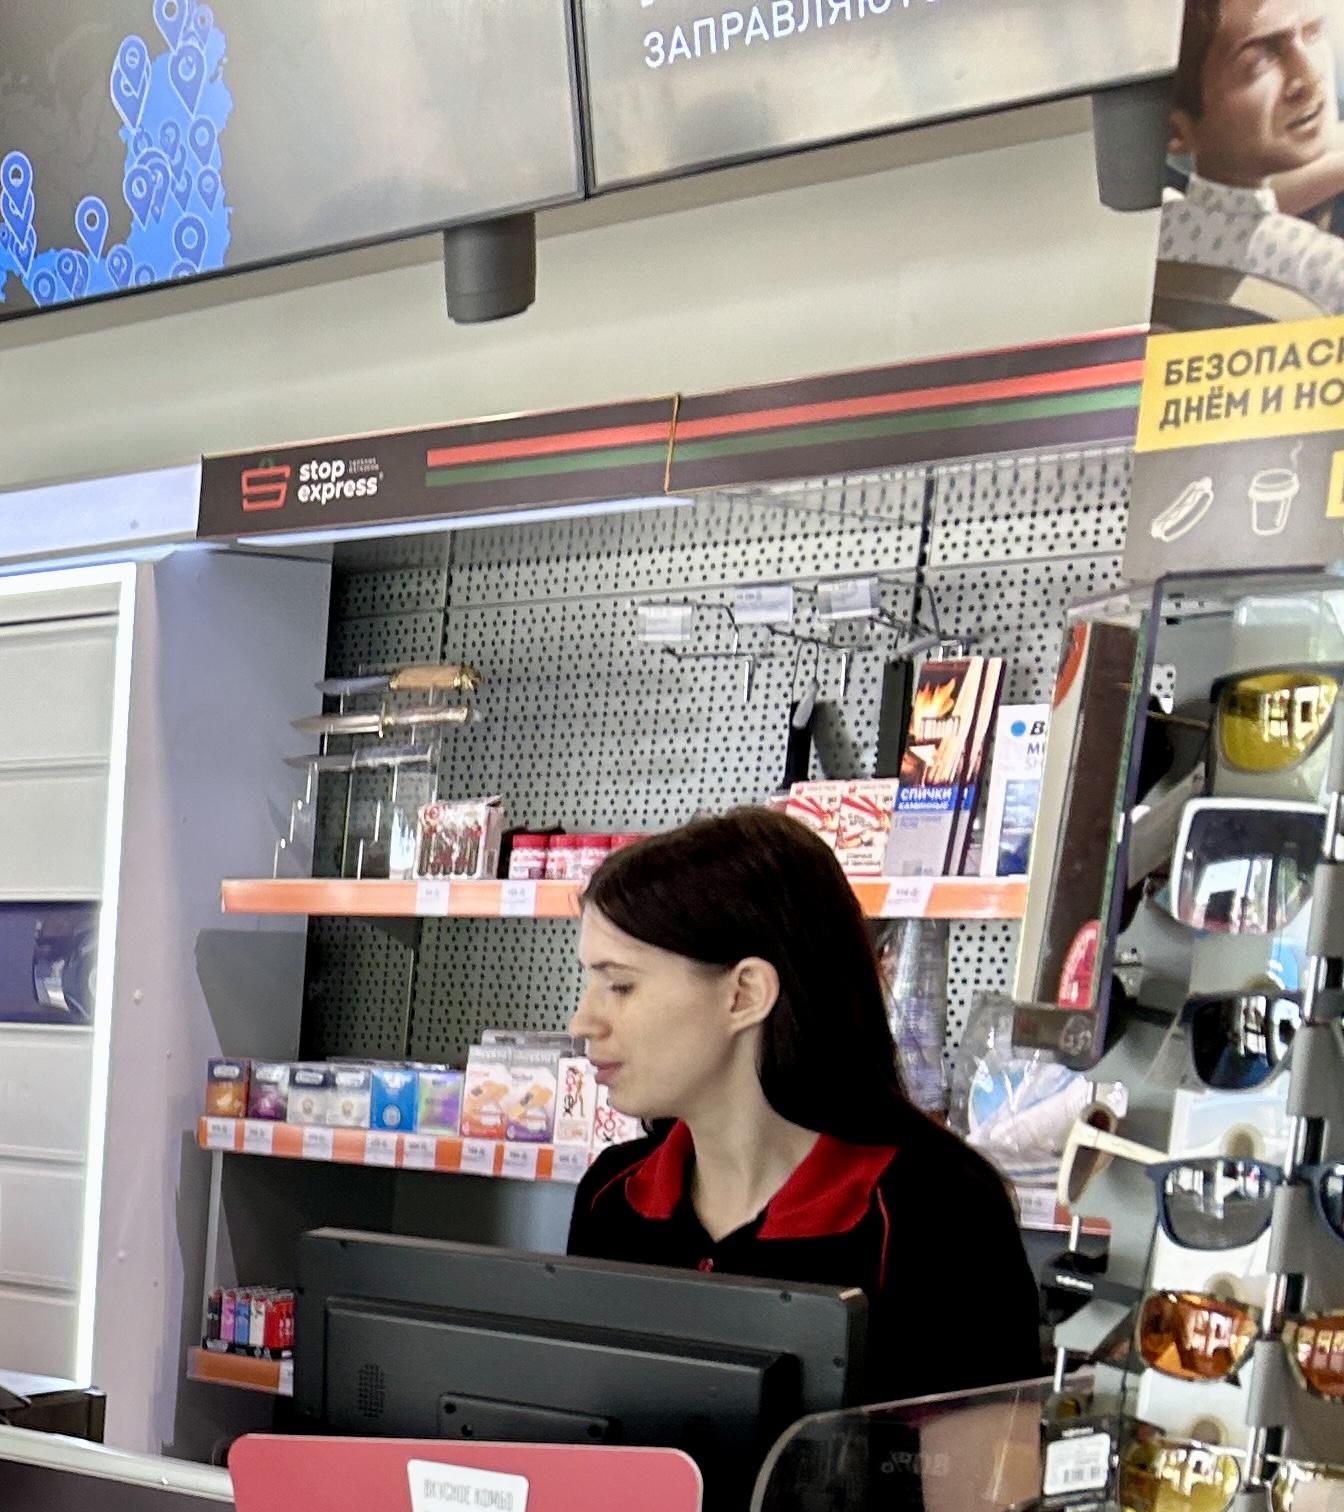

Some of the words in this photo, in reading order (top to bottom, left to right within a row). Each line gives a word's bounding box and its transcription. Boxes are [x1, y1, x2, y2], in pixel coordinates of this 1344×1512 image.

[644, 0, 934, 67] ЗАПРАВЛЯЮ
[1159, 386, 1251, 431] ДНЁМ
[1261, 386, 1284, 414] И
[299, 459, 345, 483] stop
[297, 476, 378, 505] express
[900, 785, 952, 800] СПИЧКИ
